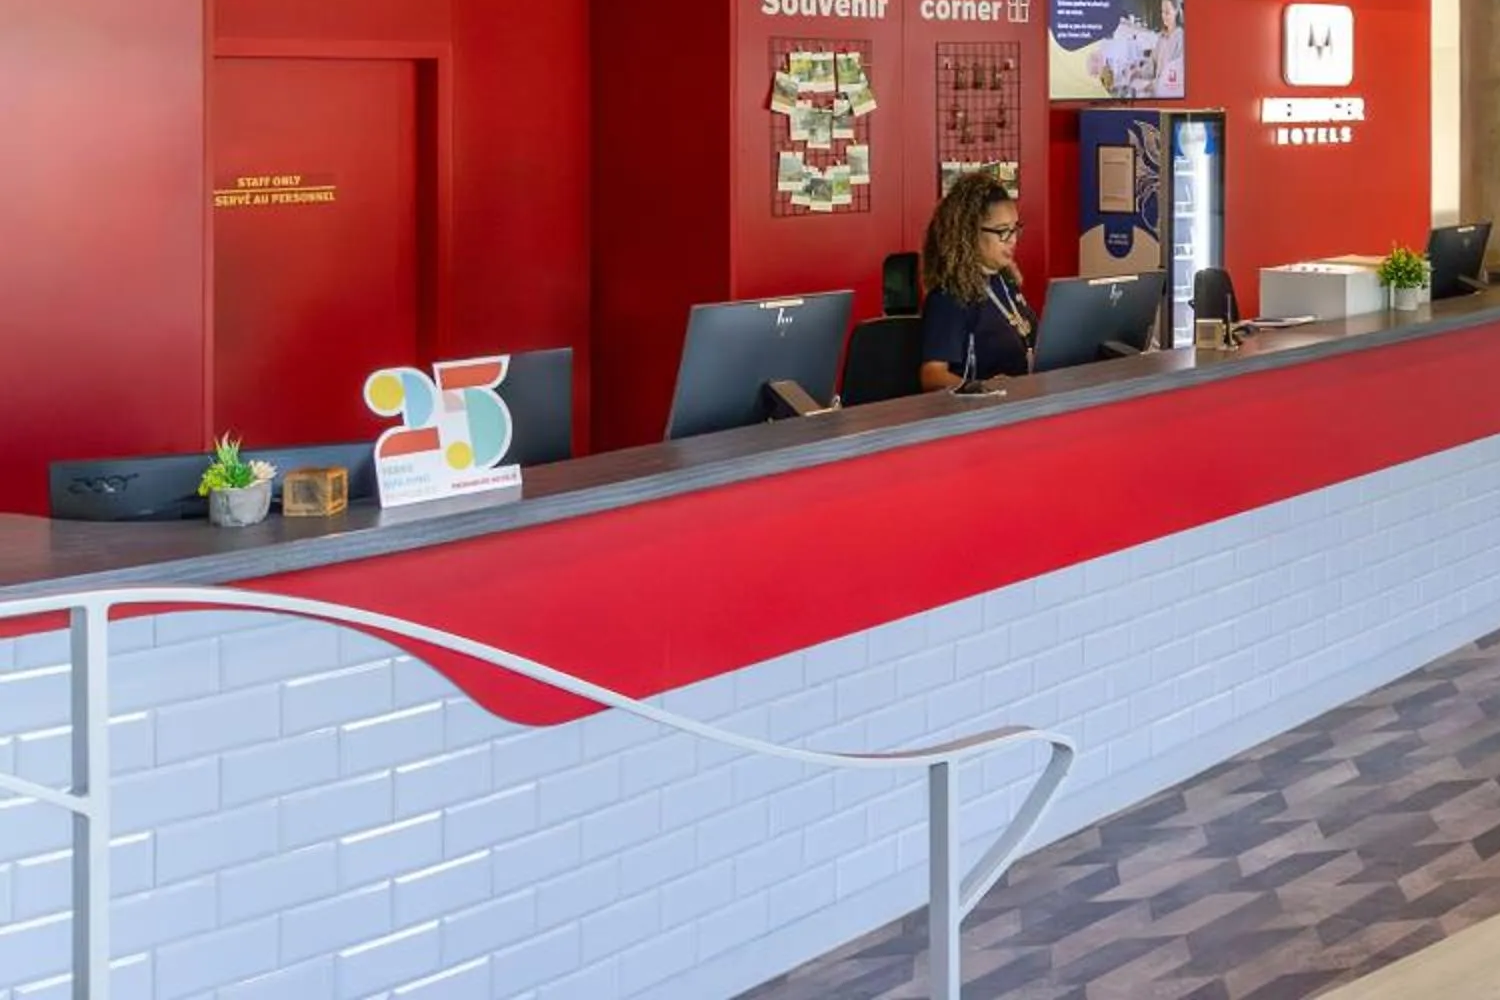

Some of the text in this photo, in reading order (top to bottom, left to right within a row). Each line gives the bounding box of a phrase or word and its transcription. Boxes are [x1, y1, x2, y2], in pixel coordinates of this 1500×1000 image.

[237, 175, 301, 188] STAFF ONLY
[253, 194, 269, 205] AU
